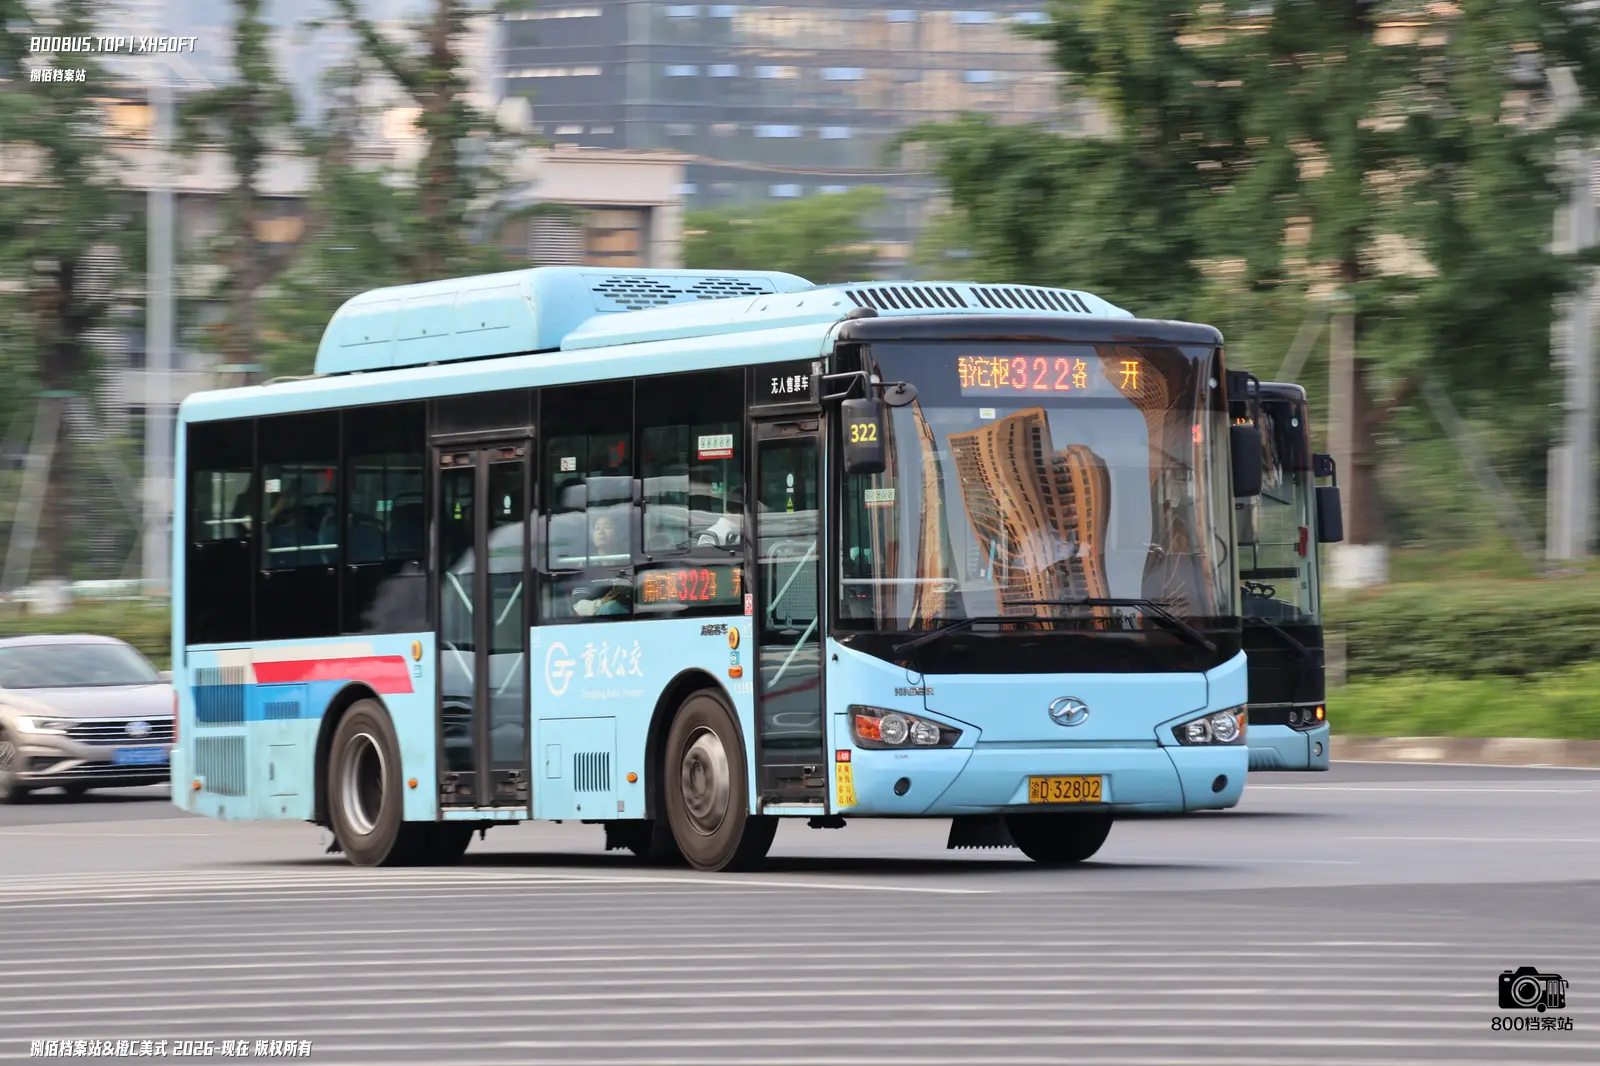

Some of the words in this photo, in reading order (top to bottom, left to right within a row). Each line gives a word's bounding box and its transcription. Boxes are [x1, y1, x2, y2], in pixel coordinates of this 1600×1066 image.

[771, 375, 809, 395] 无人售票车
[1011, 356, 1070, 391] 322
[1119, 360, 1140, 390] 开
[851, 423, 877, 443] 322
[677, 568, 711, 601] 322
[580, 639, 645, 679] 重庆公交
